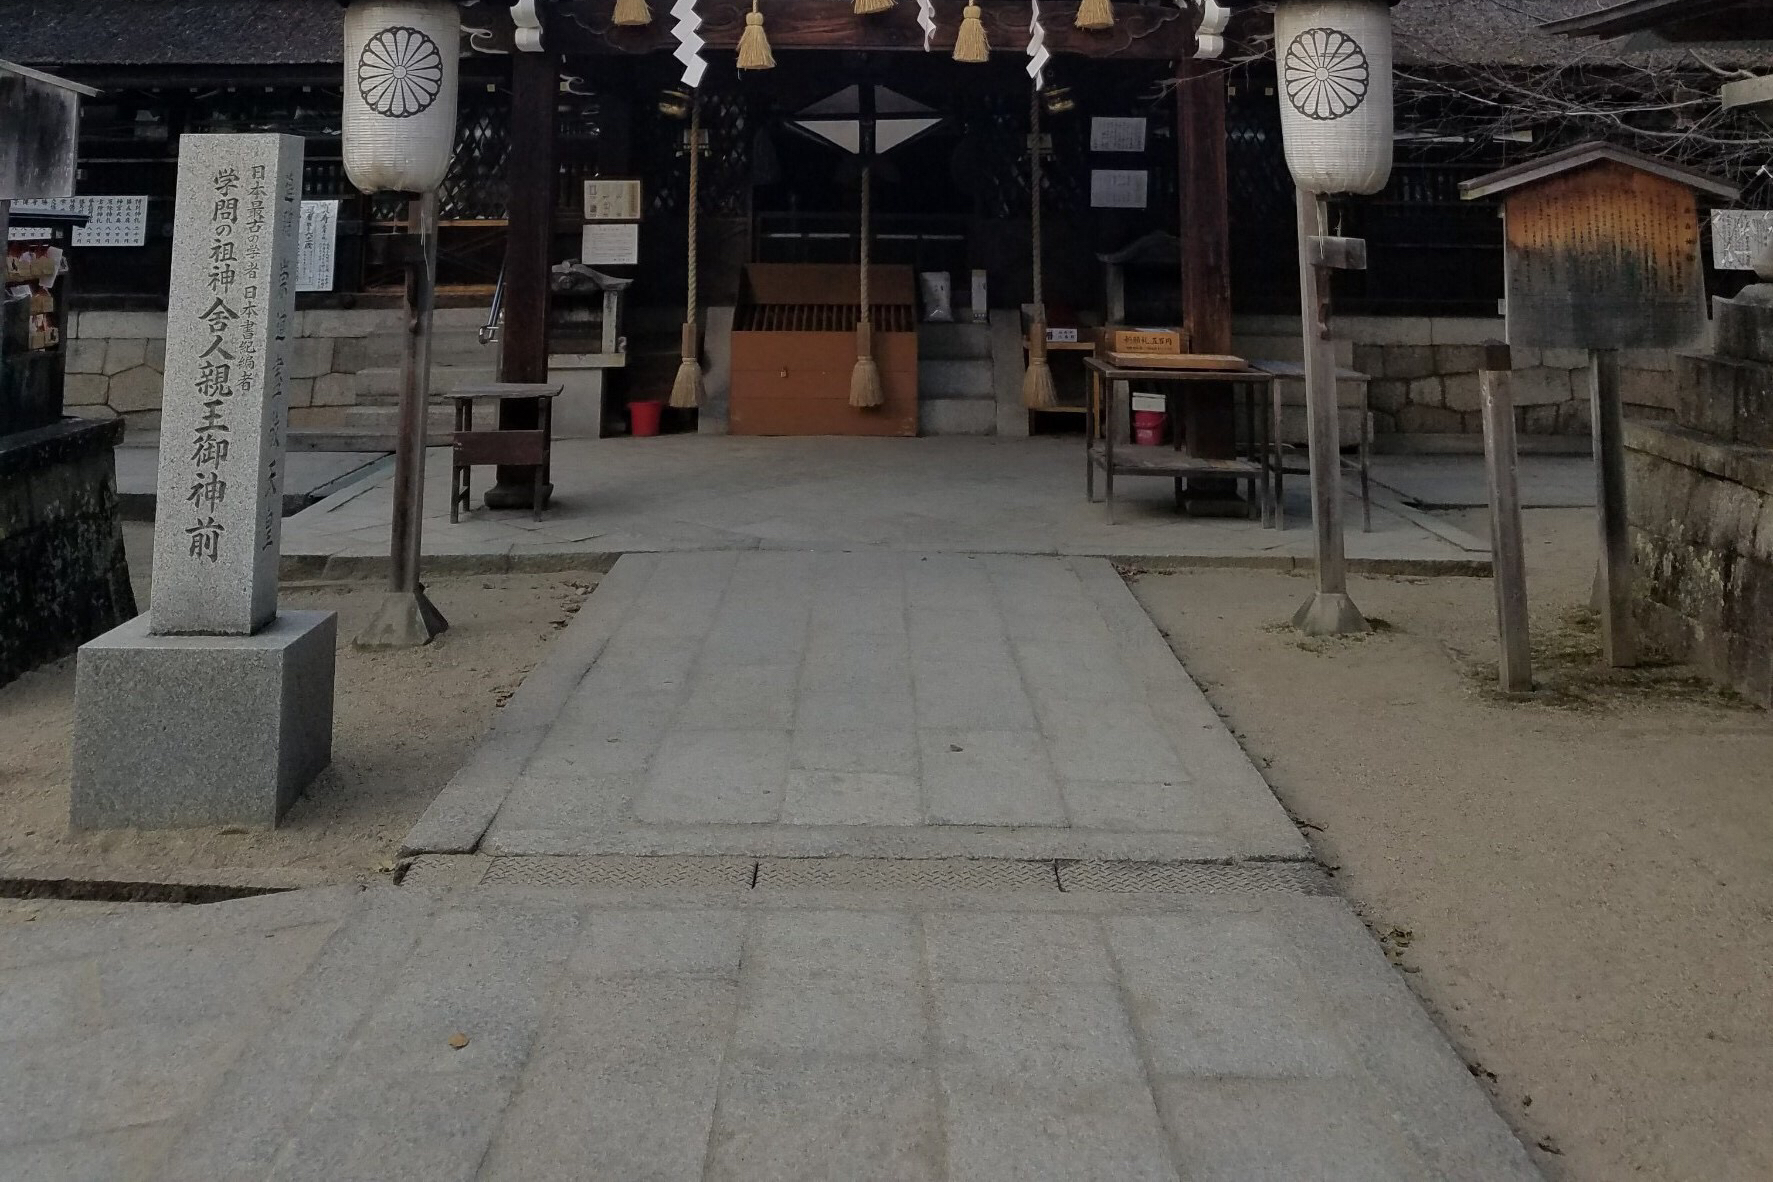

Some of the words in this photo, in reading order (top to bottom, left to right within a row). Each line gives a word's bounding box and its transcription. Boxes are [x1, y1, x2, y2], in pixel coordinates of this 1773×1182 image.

[207, 167, 241, 294] 学問の祖神
[243, 165, 269, 280] 日本最古の学者
[236, 285, 260, 392] 日本書紀編者
[185, 296, 241, 563] 舎人親王御神前
